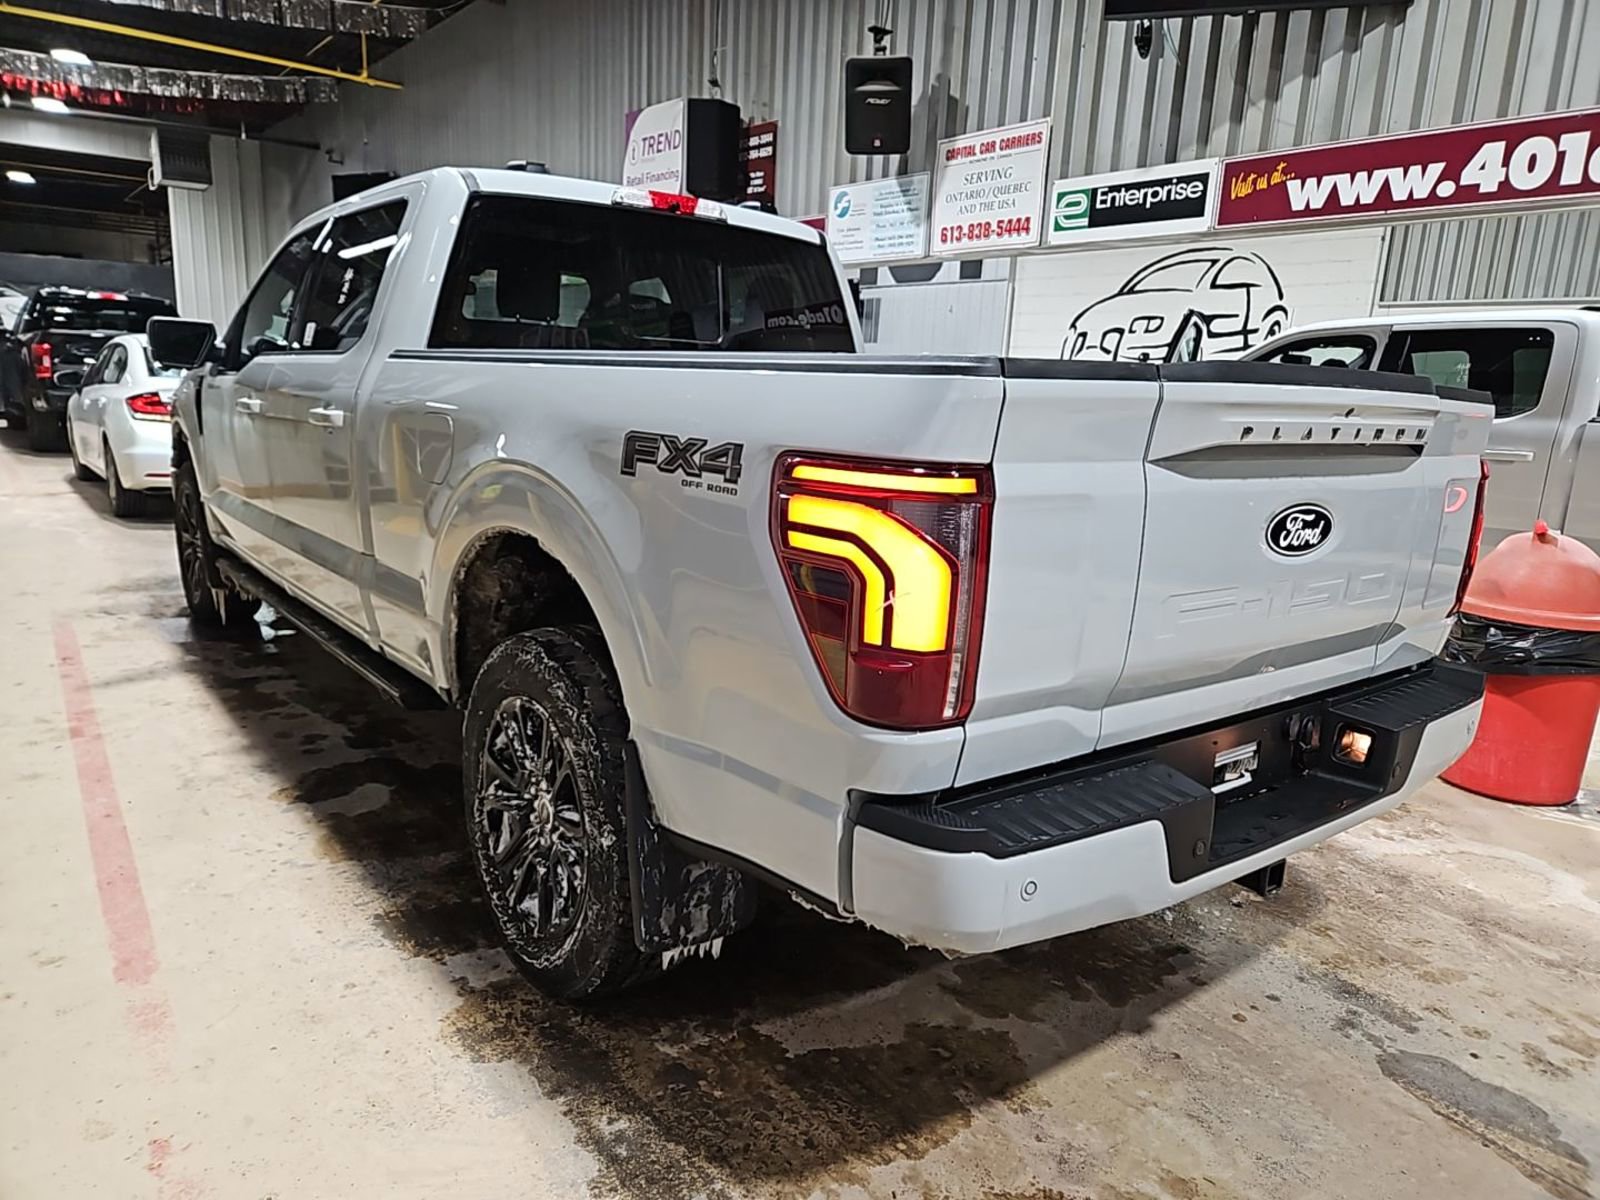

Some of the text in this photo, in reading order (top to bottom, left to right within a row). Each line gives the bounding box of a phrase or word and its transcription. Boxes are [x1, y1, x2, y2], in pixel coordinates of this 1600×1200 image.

[641, 129, 682, 157] TREND
[945, 144, 977, 161] CAPITAL
[979, 140, 997, 155] CAR
[999, 131, 1044, 151] CARRIERS
[626, 168, 680, 187] Retail Financing
[963, 166, 1014, 186] SERVING
[1231, 172, 1254, 200] Visit
[1256, 172, 1268, 190] us
[957, 198, 1017, 216] AND THE USA
[1095, 178, 1204, 210] Enterprise
[940, 216, 1031, 244] 613-838-5444
[1239, 425, 1429, 442] PLATINUM
[620, 429, 745, 485] FX4
[680, 478, 739, 497] OFF ROAD
[1279, 512, 1326, 548] Ford
